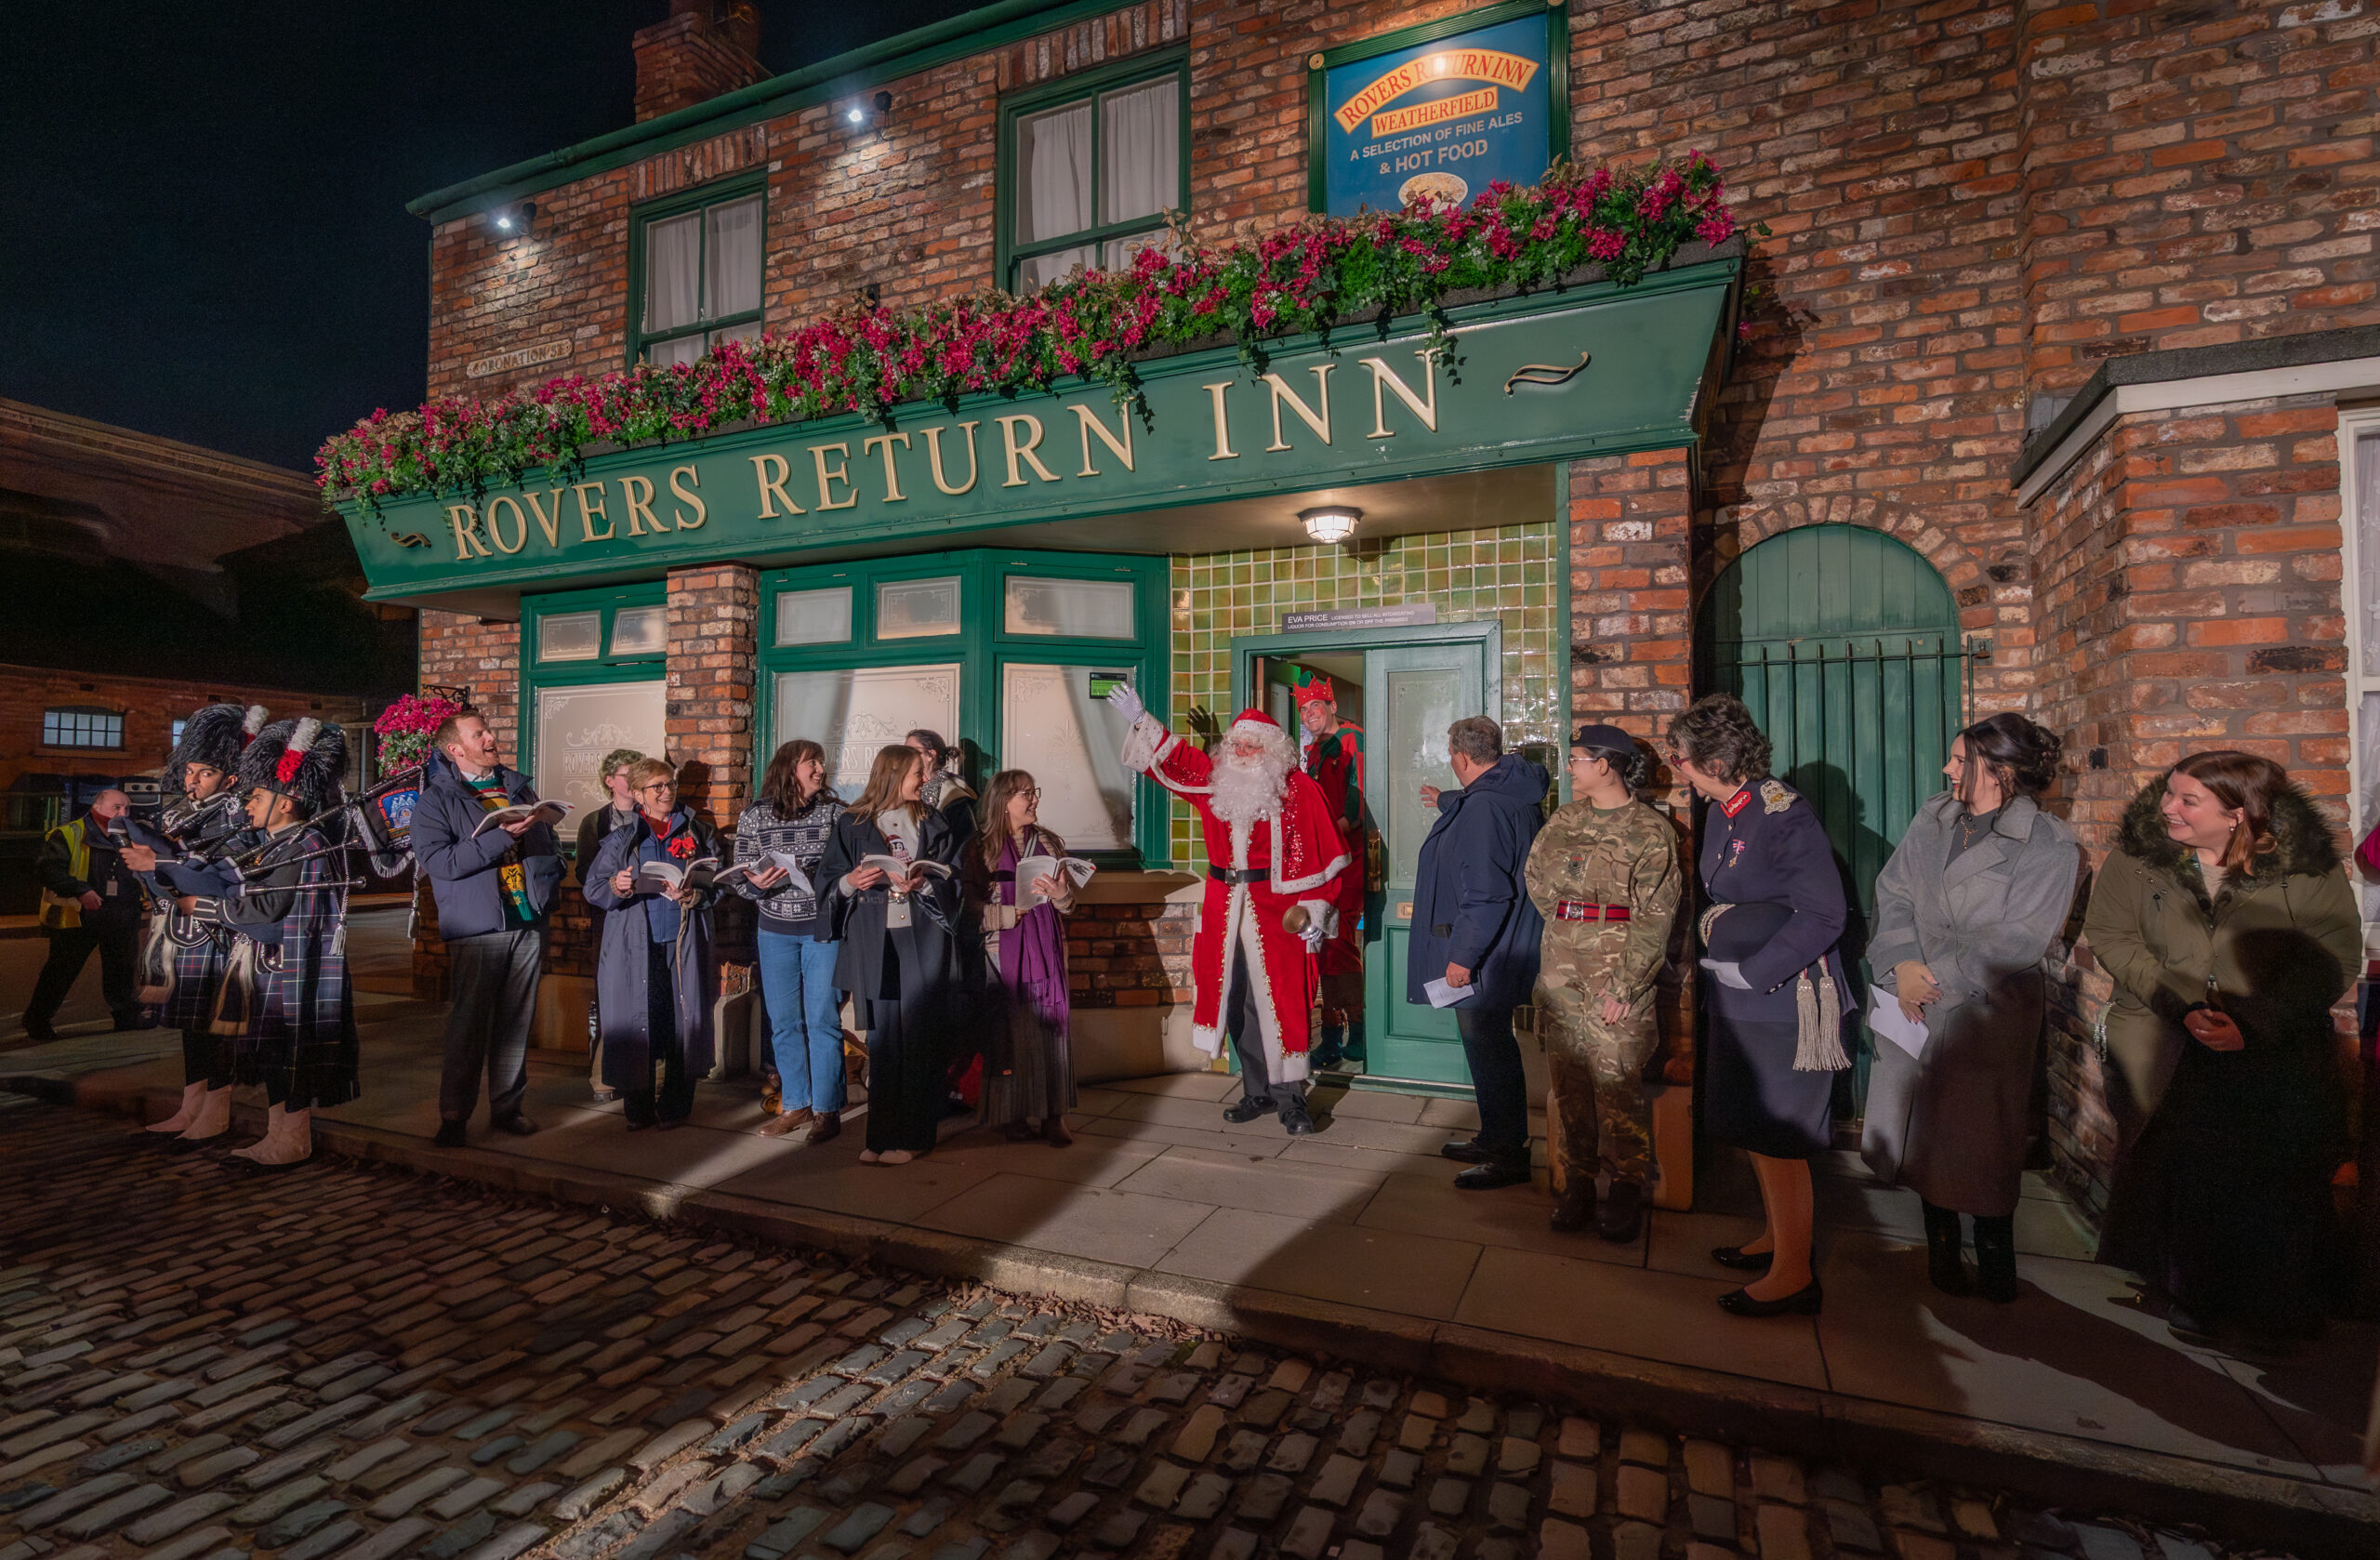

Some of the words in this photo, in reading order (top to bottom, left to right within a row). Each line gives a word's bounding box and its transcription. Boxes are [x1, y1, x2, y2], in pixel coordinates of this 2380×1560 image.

[1342, 69, 1412, 126] ROVERS
[1491, 57, 1530, 86] INN
[1375, 90, 1495, 134] WEATHERFIELD
[1350, 150, 1359, 161] A
[1362, 132, 1432, 158] SELECTION
[1435, 128, 1452, 140] OF
[1455, 121, 1485, 138] FINE
[1488, 112, 1523, 130] ALES
[1379, 162, 1391, 175] &
[1395, 150, 1433, 174] HOT
[1438, 139, 1488, 165] FOOD
[472, 349, 547, 375] CORONATION
[550, 343, 565, 358] ST
[447, 464, 708, 561] ROVERS
[749, 397, 1136, 521] RETURN
[1202, 347, 1443, 461] INN
[1288, 615, 1302, 624] EVA
[1304, 614, 1328, 622] PRICE
[564, 752, 601, 774] ROVERS
